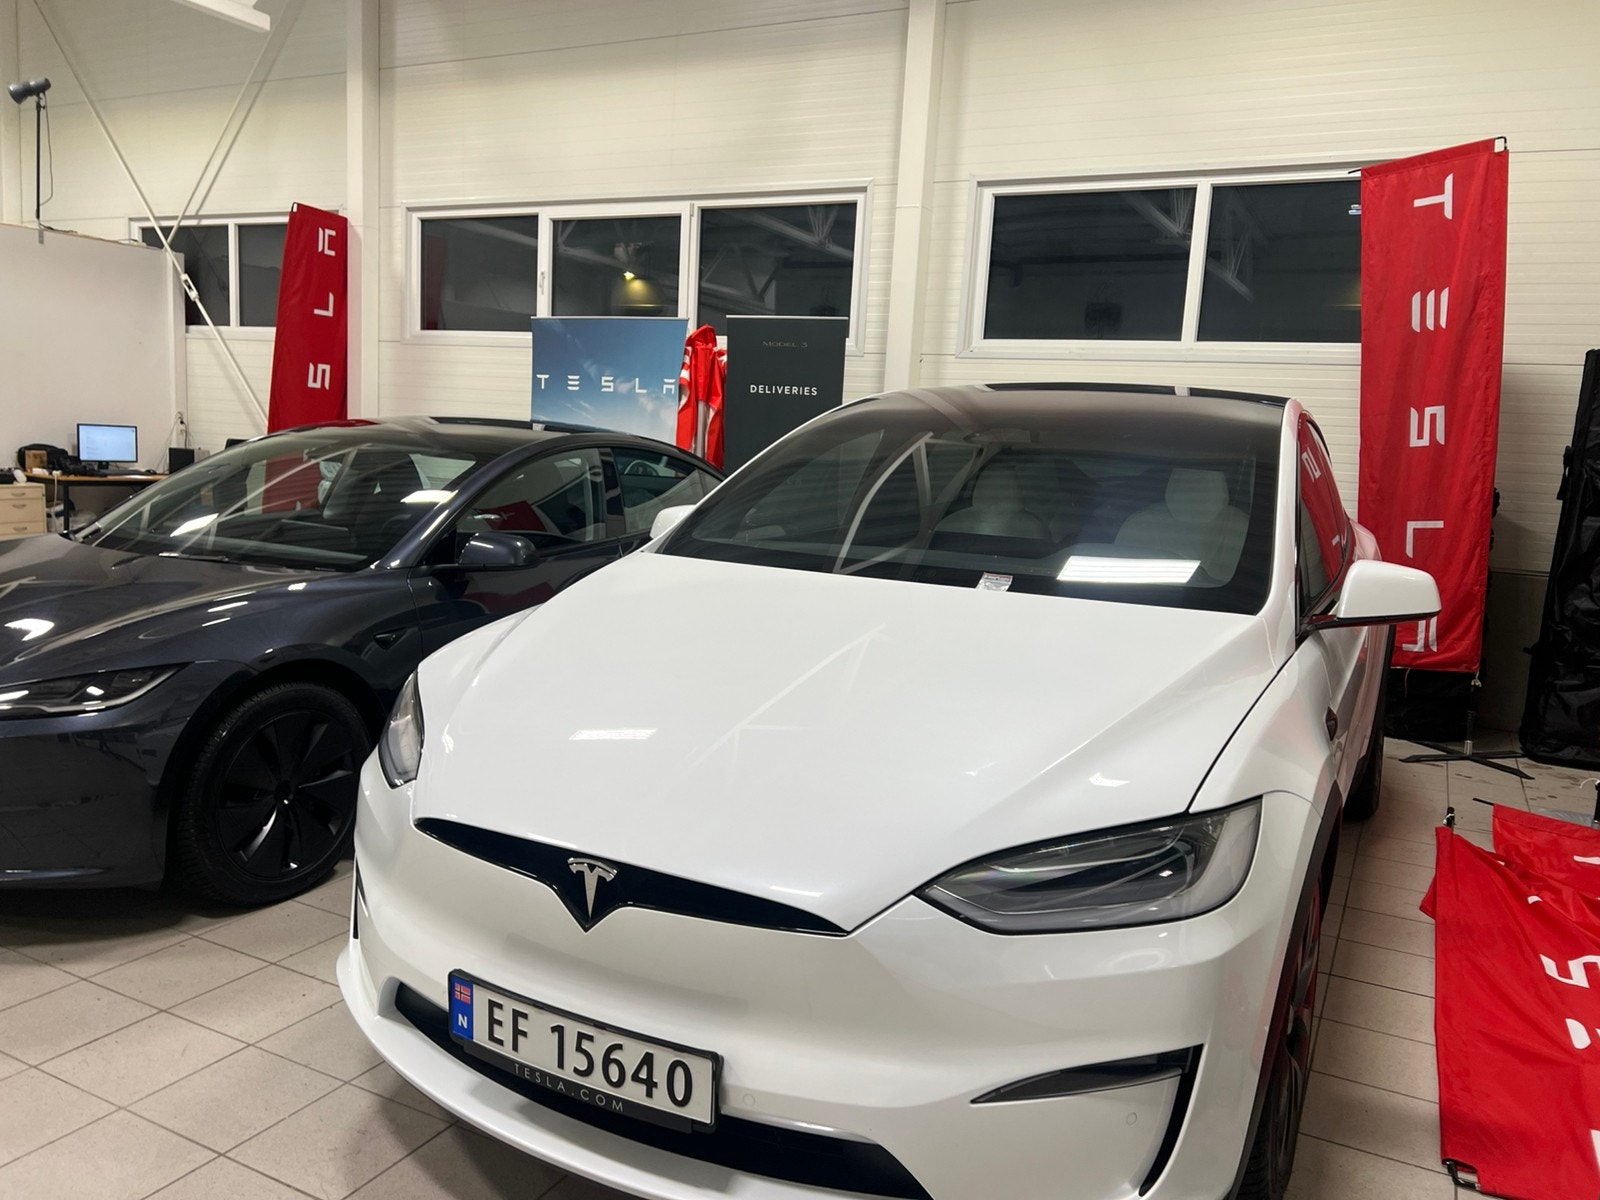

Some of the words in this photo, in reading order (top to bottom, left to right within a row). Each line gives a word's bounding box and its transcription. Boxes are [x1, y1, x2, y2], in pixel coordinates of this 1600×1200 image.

[307, 227, 336, 390] SLA
[536, 374, 676, 394] TESLA
[749, 384, 818, 396] DELIVERIES
[458, 1012, 468, 1029] N
[487, 998, 529, 1053] EF
[550, 1024, 693, 1108] 15640
[513, 1062, 625, 1113] TESLA.COM
